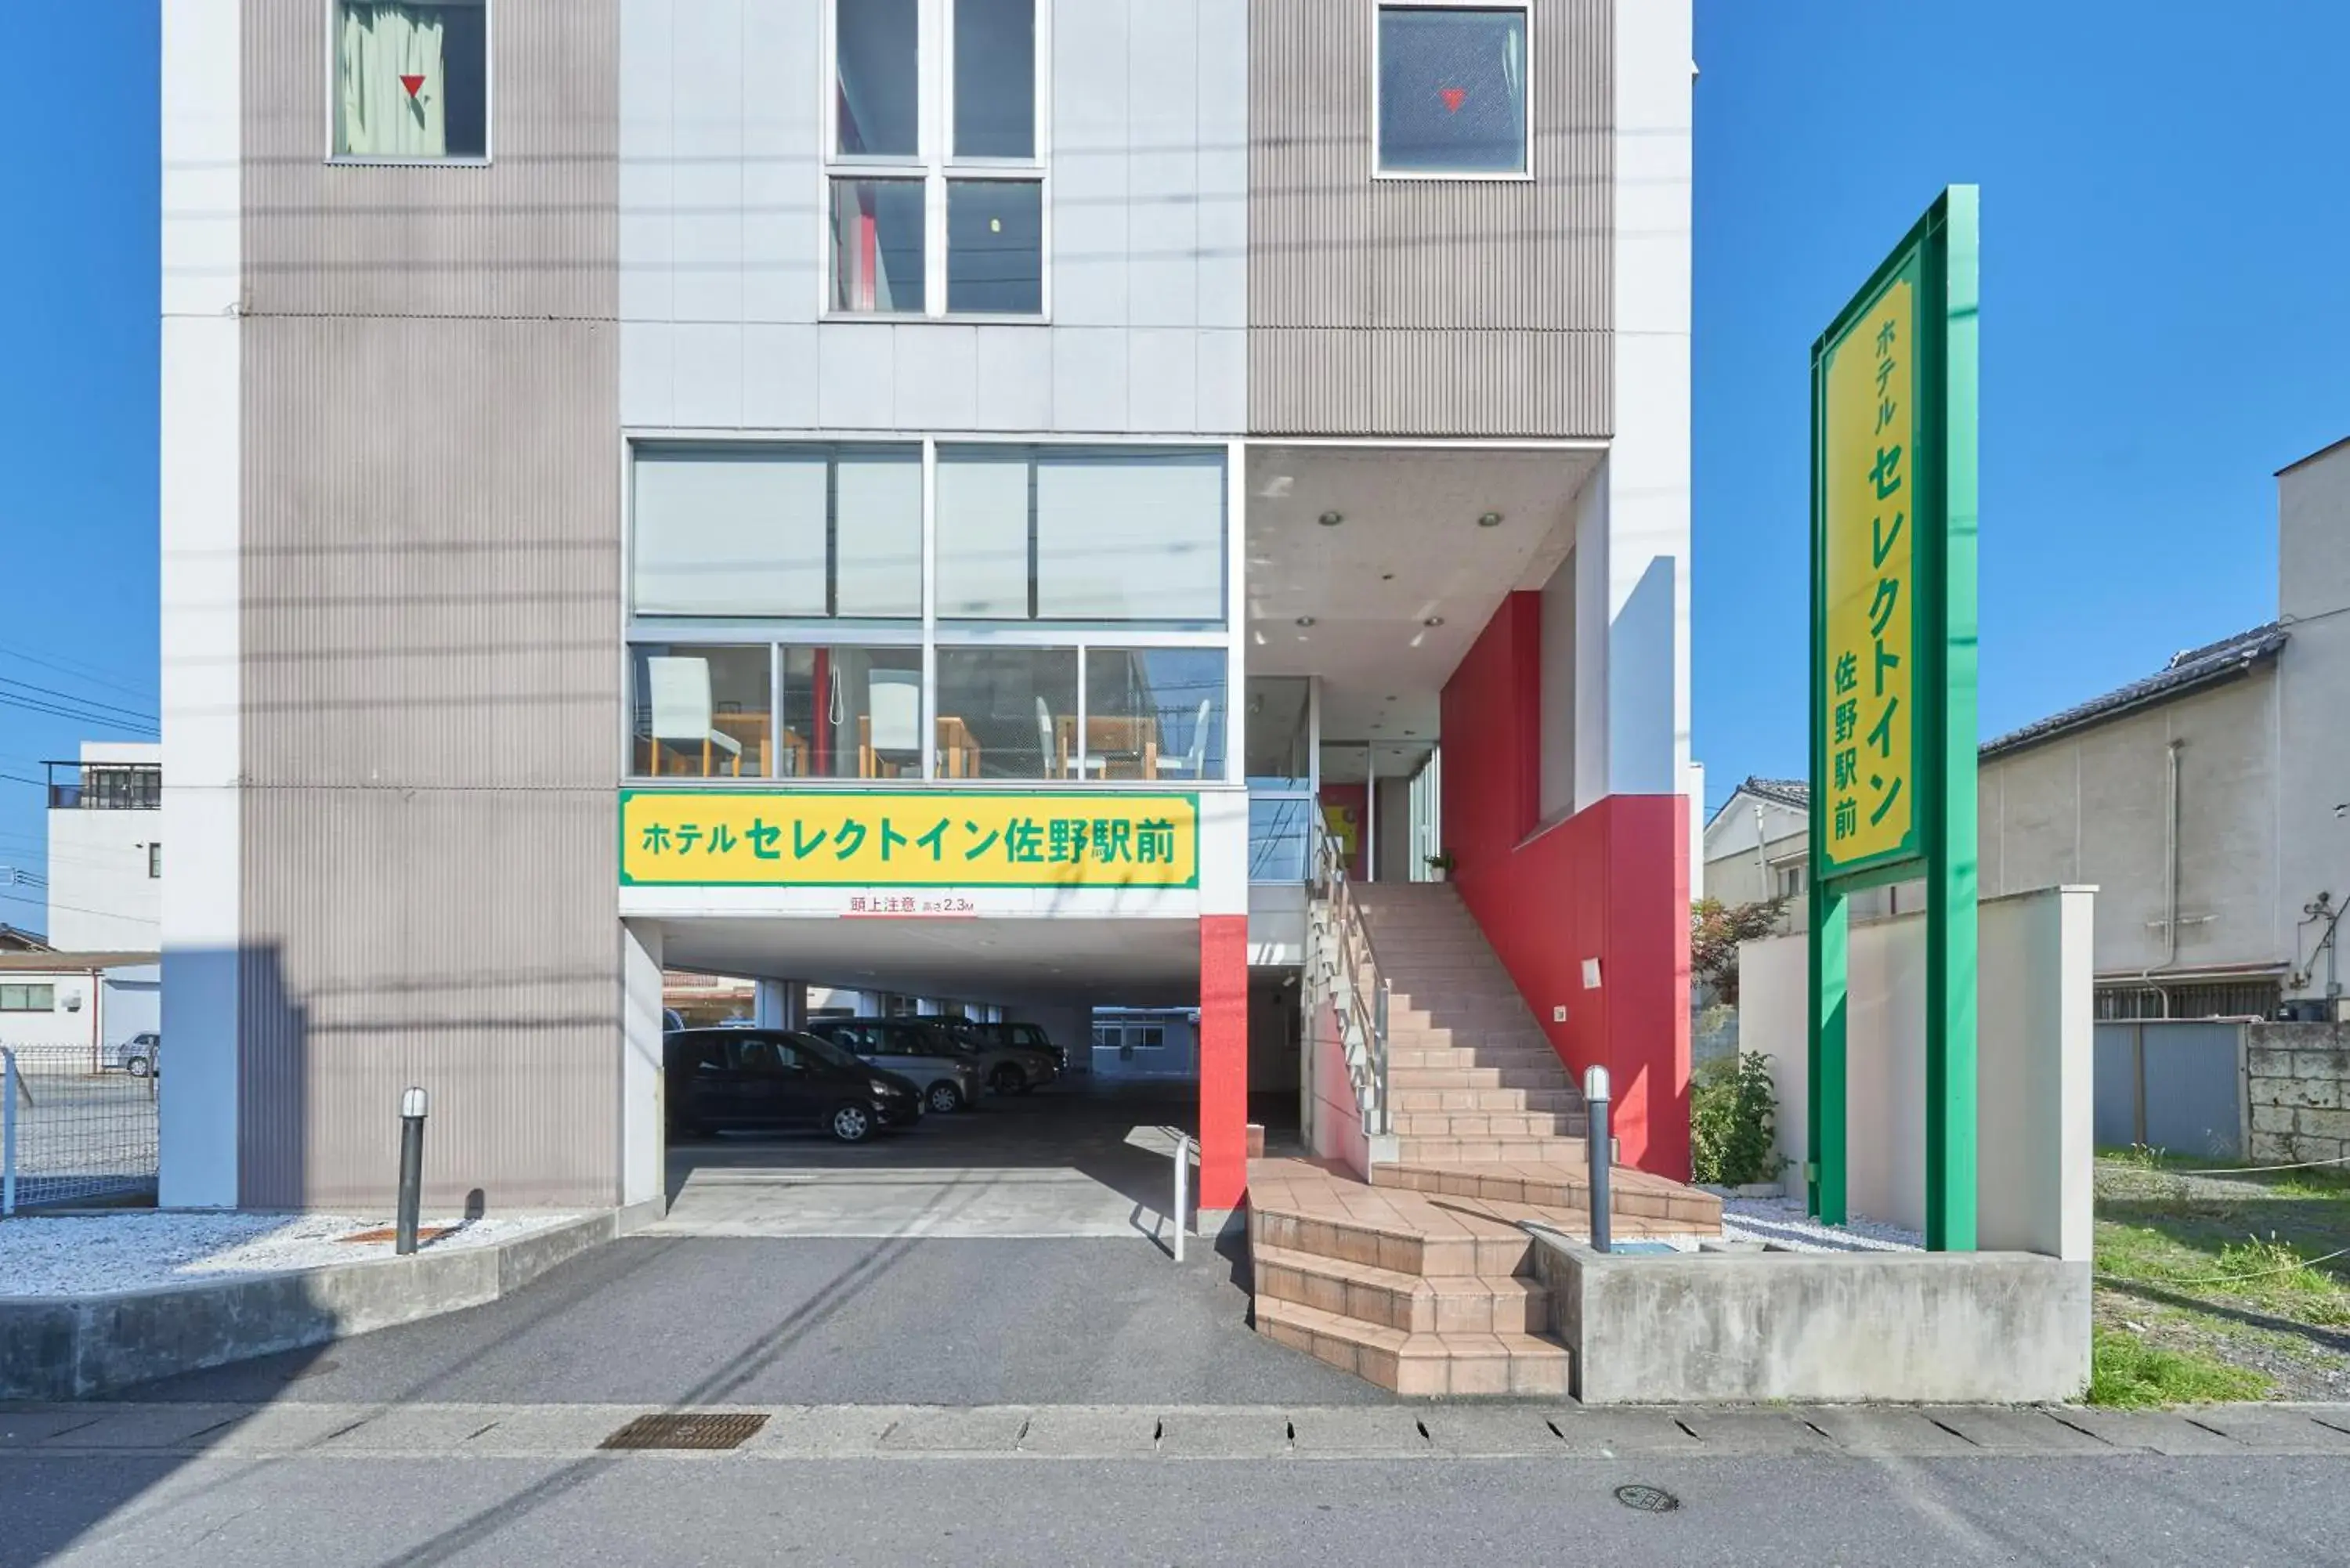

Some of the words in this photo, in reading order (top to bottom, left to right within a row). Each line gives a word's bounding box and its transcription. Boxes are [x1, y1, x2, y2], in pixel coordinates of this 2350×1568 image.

[1835, 651, 1857, 840] 佐野駅前
[851, 897, 916, 912] 頭上注意
